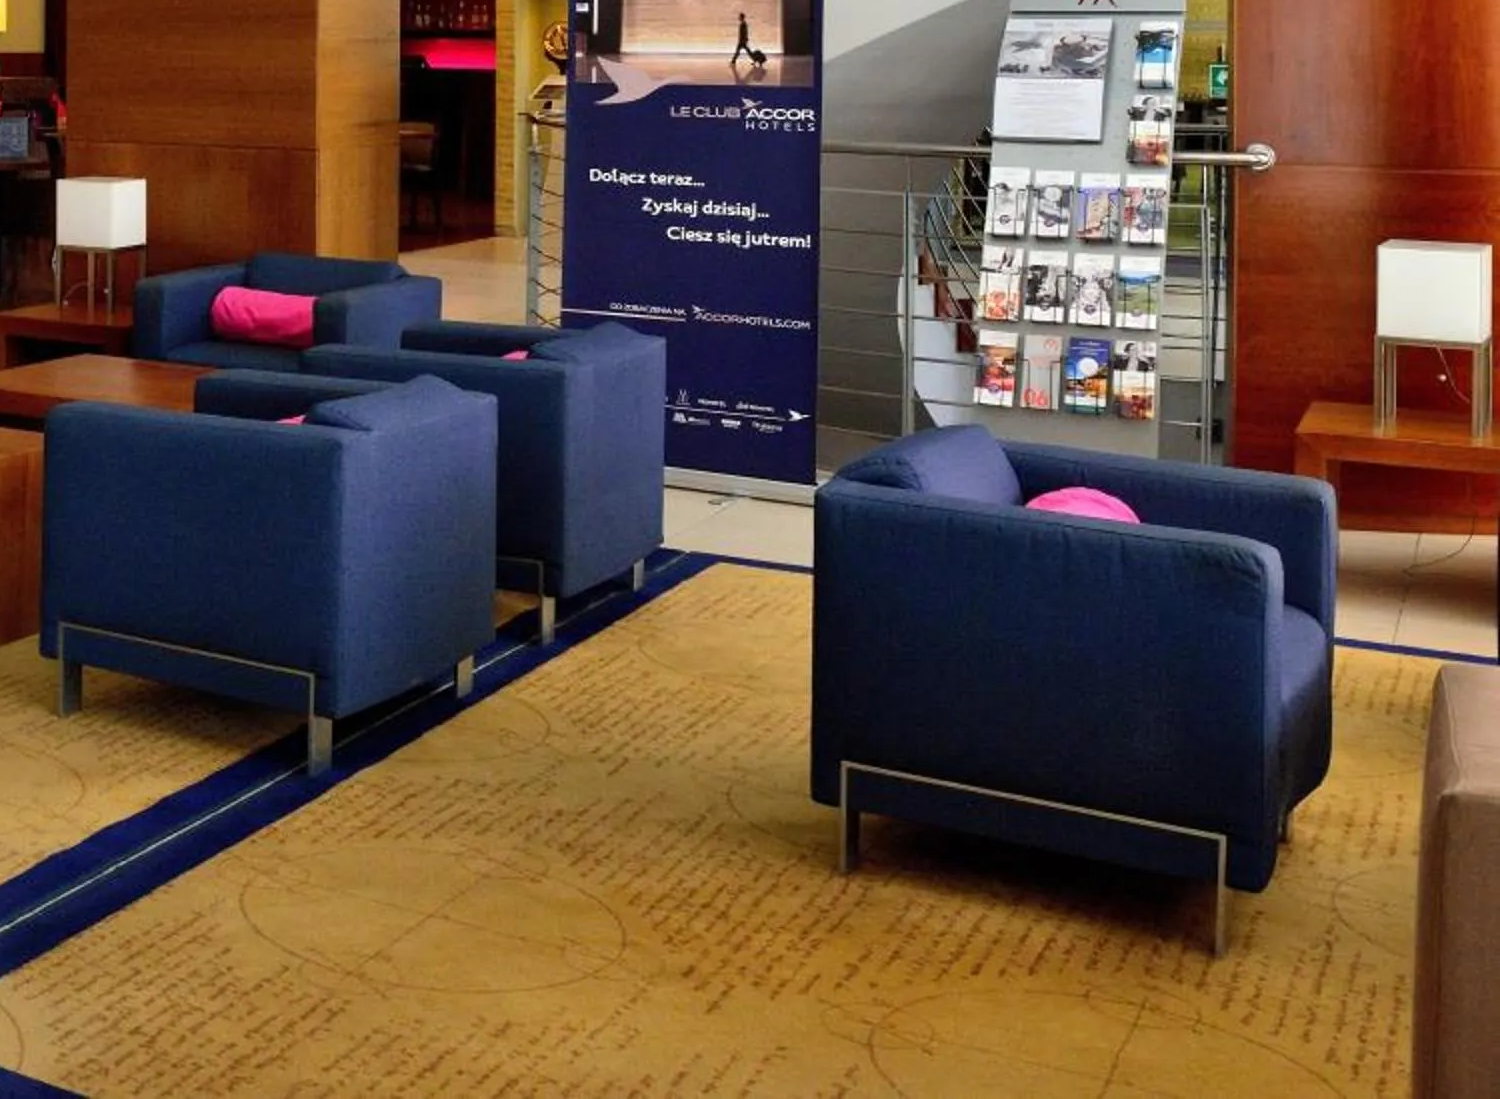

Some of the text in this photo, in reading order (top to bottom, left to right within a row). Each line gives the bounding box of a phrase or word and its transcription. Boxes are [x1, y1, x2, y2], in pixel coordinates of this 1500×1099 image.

[669, 105, 816, 121] LE CLUB ACCOR
[745, 120, 816, 133] HOTELS
[589, 168, 705, 187] Dołącz teraz...
[642, 197, 769, 220] Zyskaj dzisiaj...
[667, 226, 811, 248] Ciesz się jutrem!
